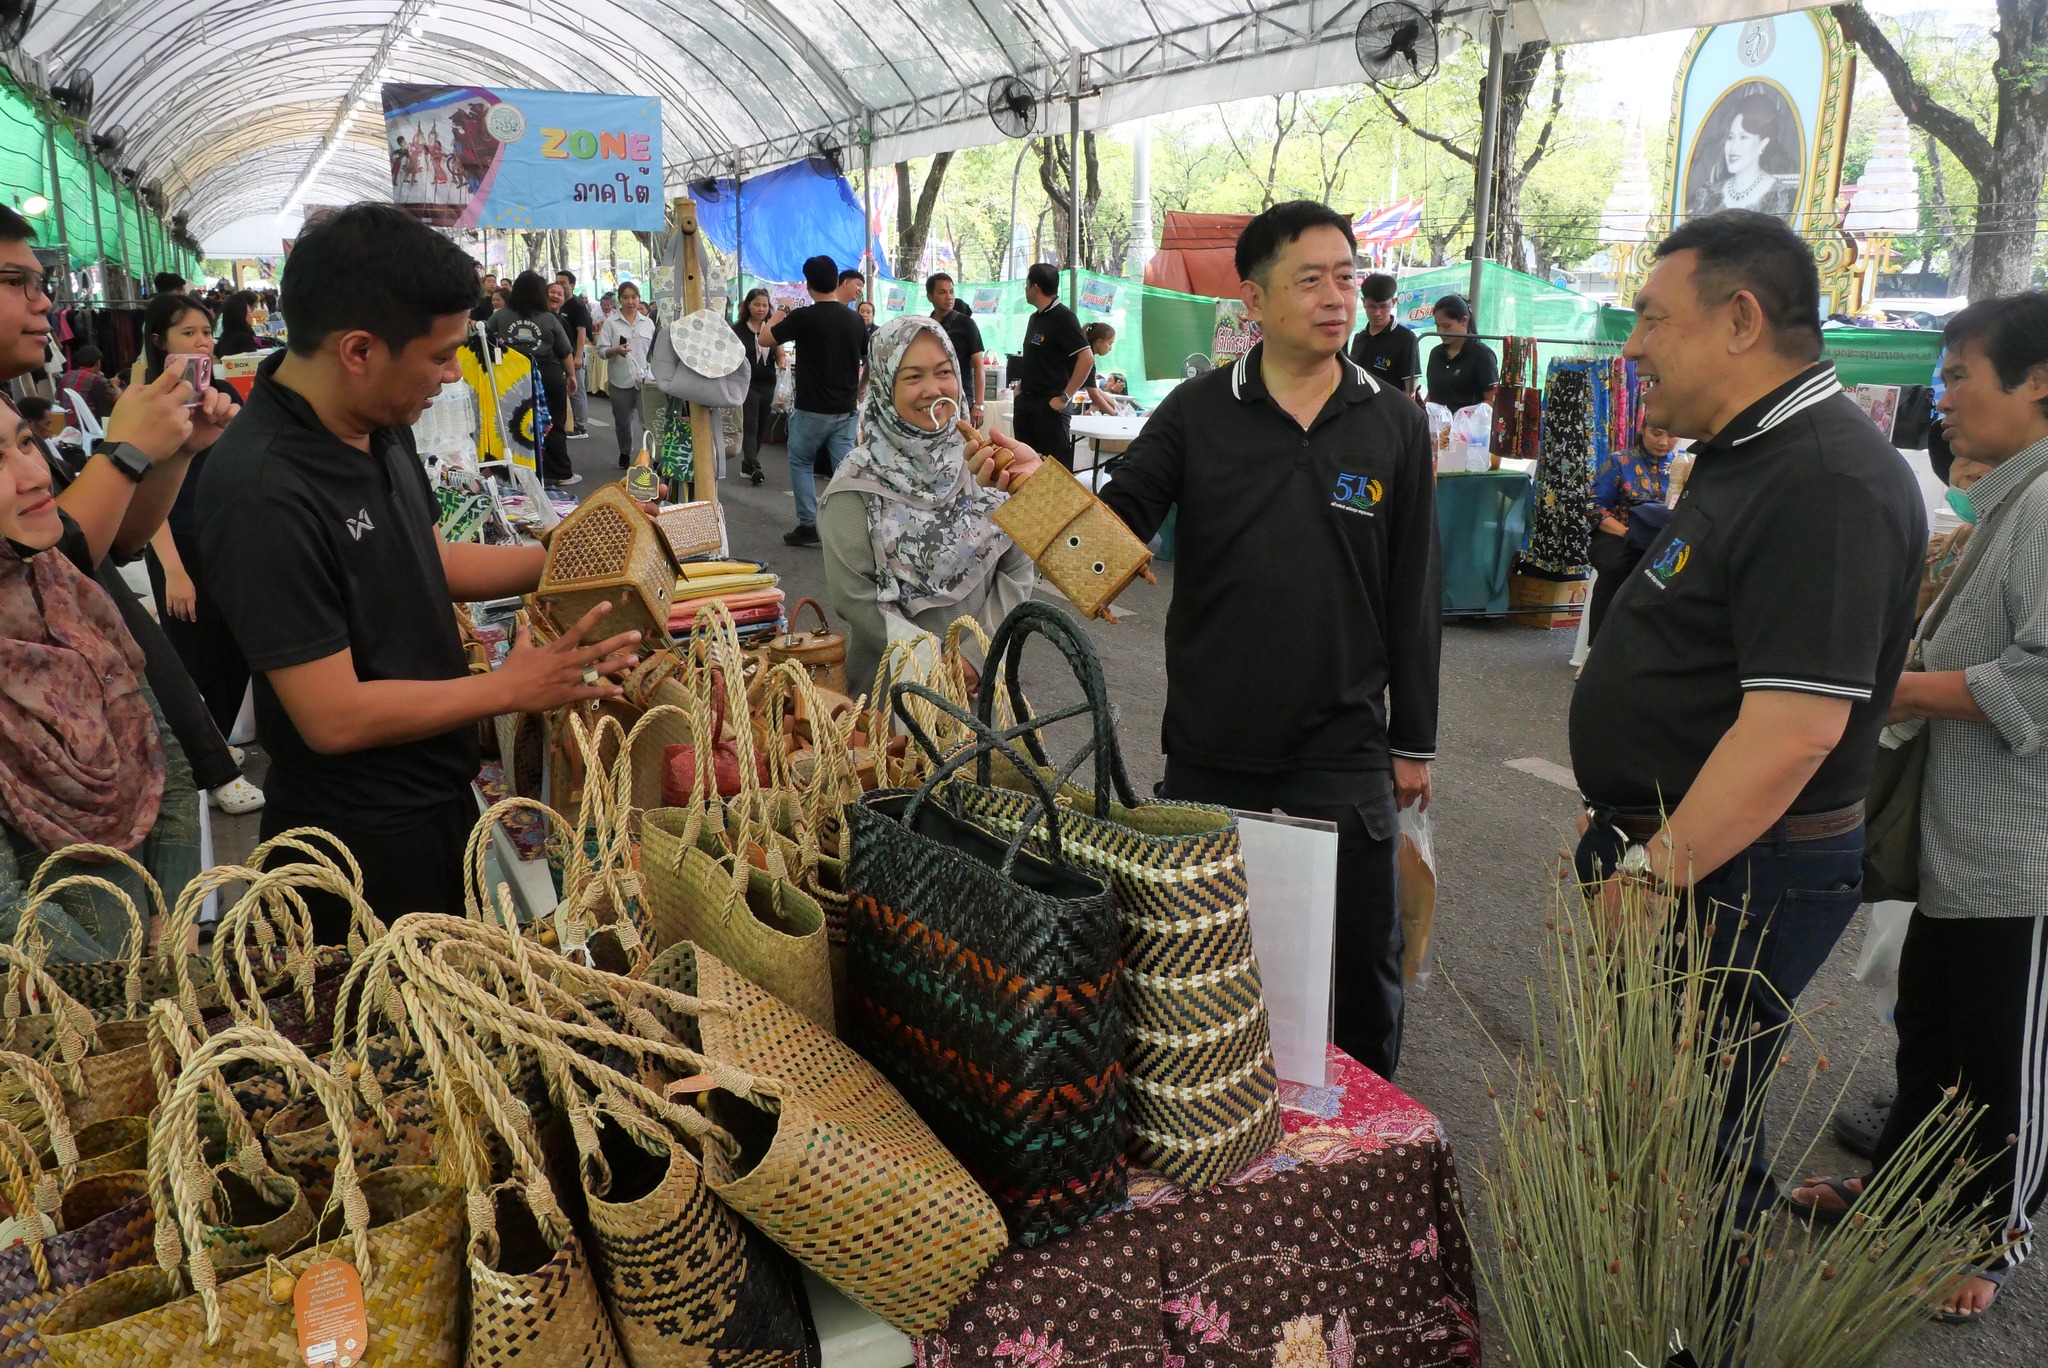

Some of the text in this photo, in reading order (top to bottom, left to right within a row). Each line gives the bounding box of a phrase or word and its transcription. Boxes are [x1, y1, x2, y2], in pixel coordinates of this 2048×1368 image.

[540, 128, 652, 161] ZONE
[573, 166, 650, 204] ภาคใต้
[1333, 472, 1368, 501] 51
